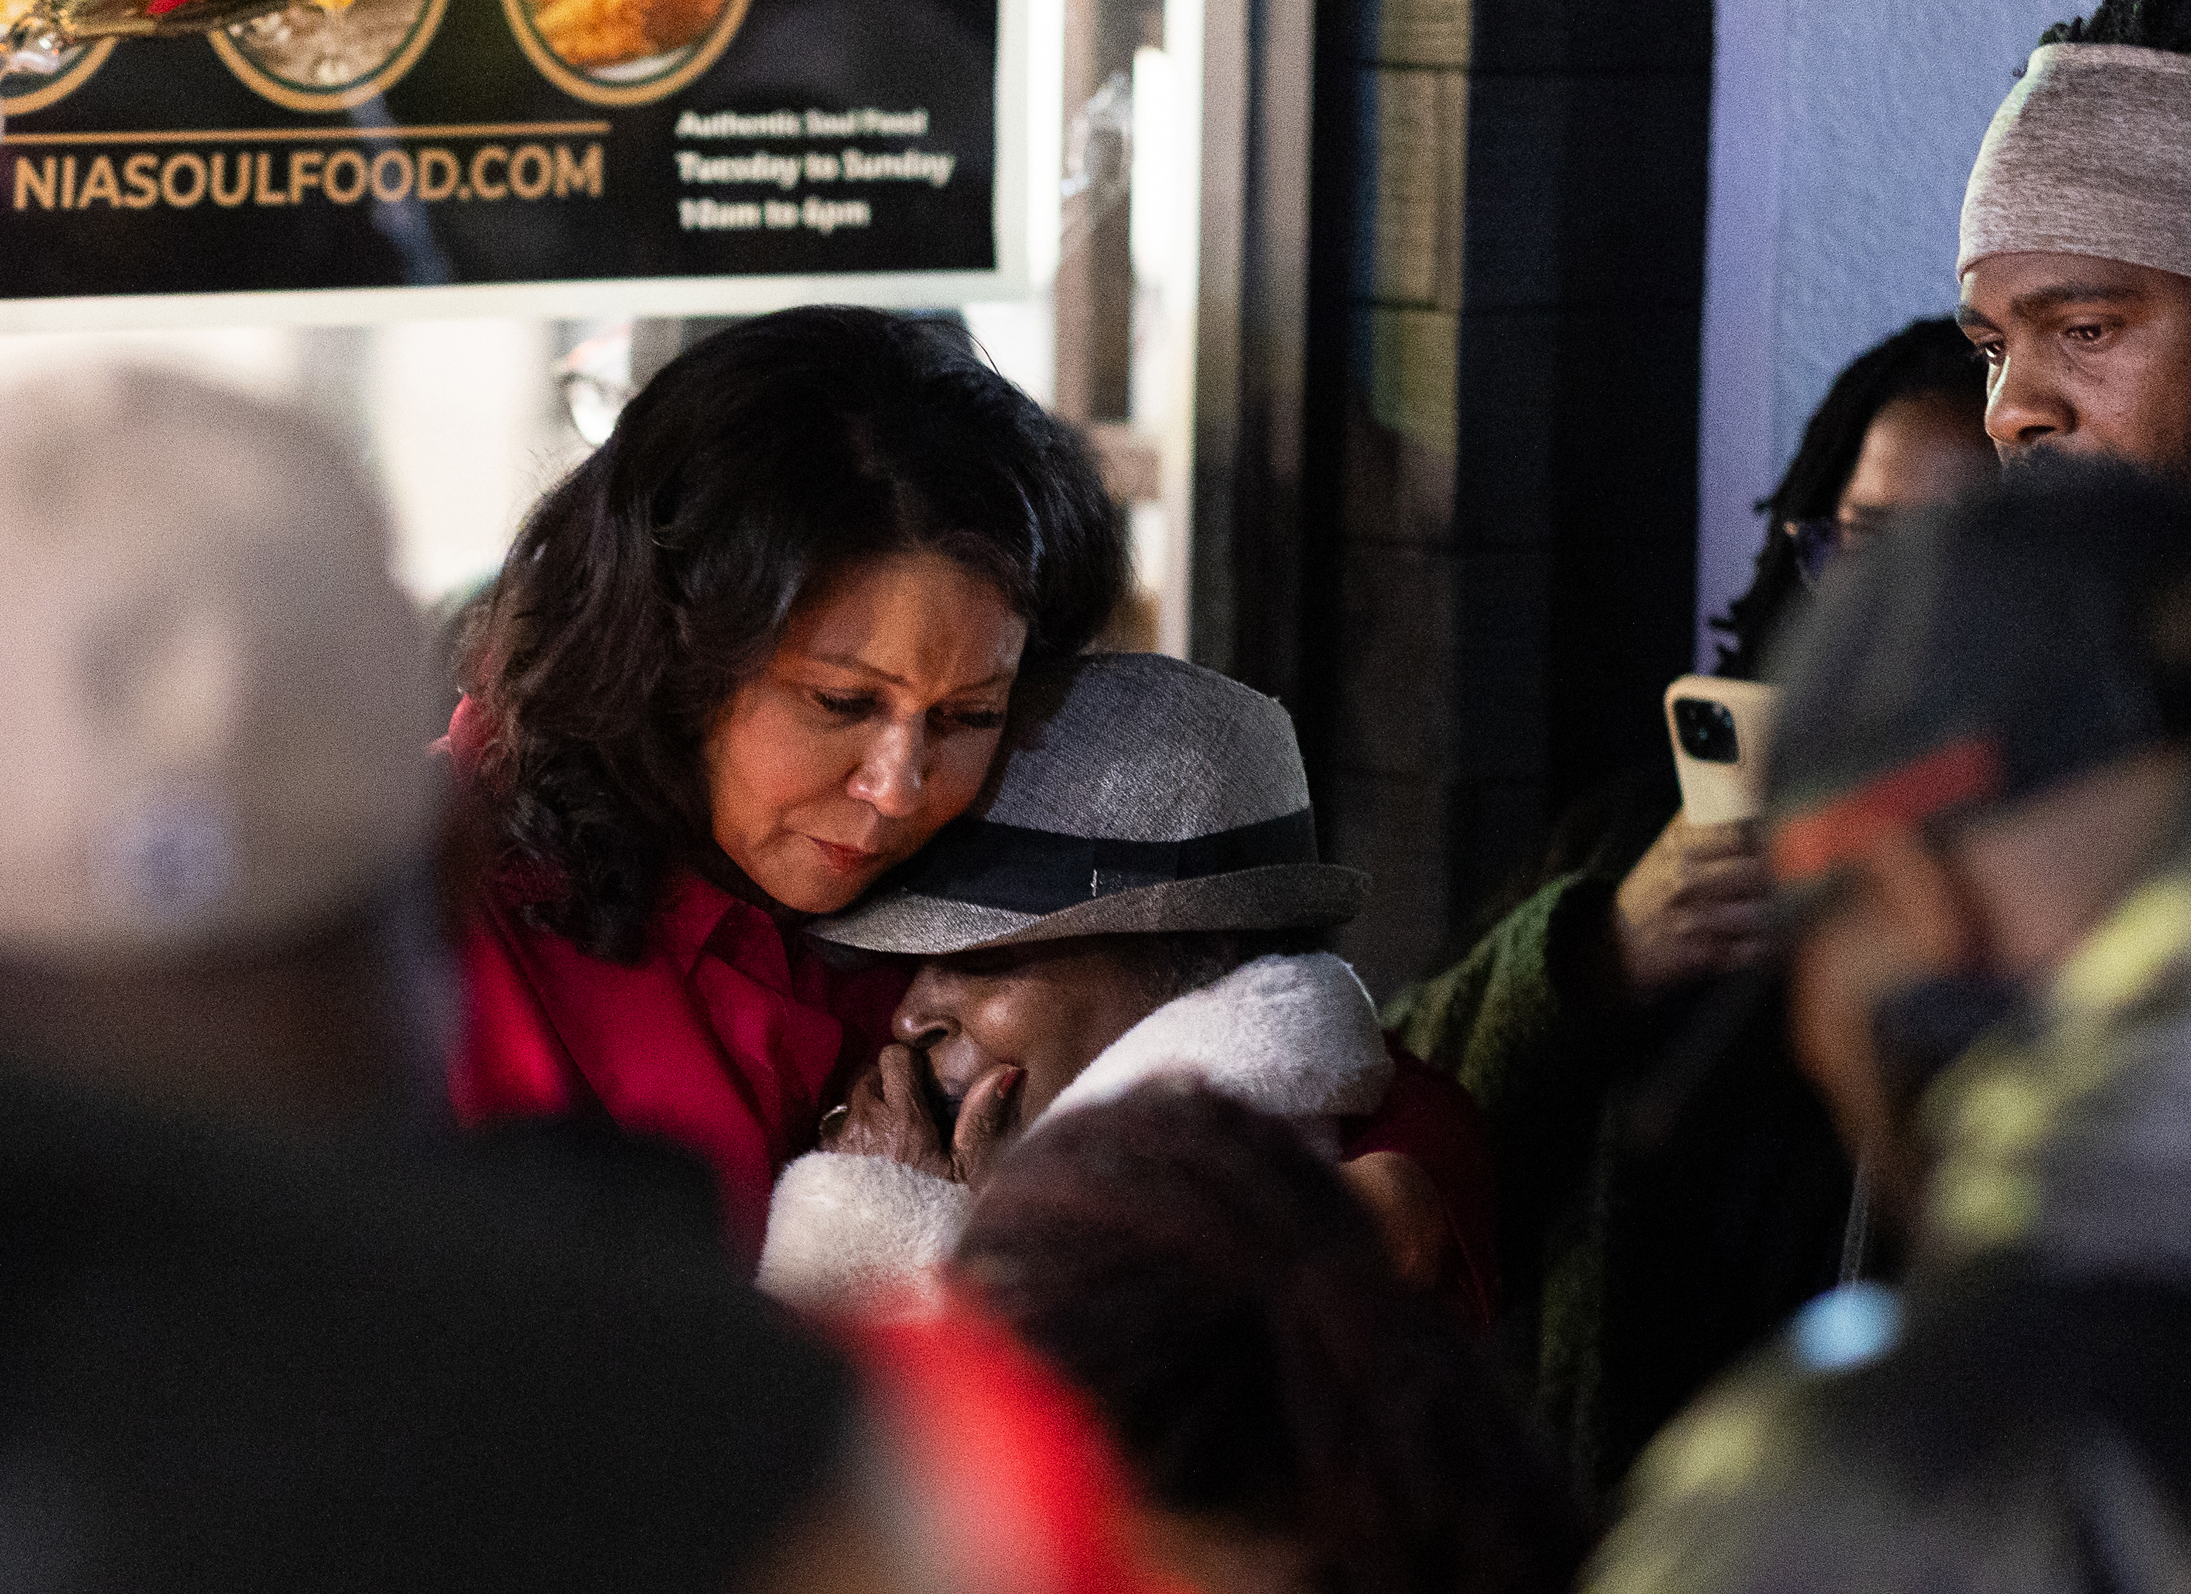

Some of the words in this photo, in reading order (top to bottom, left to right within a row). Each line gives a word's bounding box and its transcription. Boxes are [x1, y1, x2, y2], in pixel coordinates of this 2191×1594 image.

[676, 111, 801, 137] Authentic
[804, 110, 851, 135] Soul
[857, 108, 928, 135] Food
[13, 144, 604, 210] NIASOULFOOD.COM
[676, 151, 798, 188] Tuesday
[803, 153, 839, 180] to
[842, 148, 954, 186] Sunday
[764, 201, 799, 228] to
